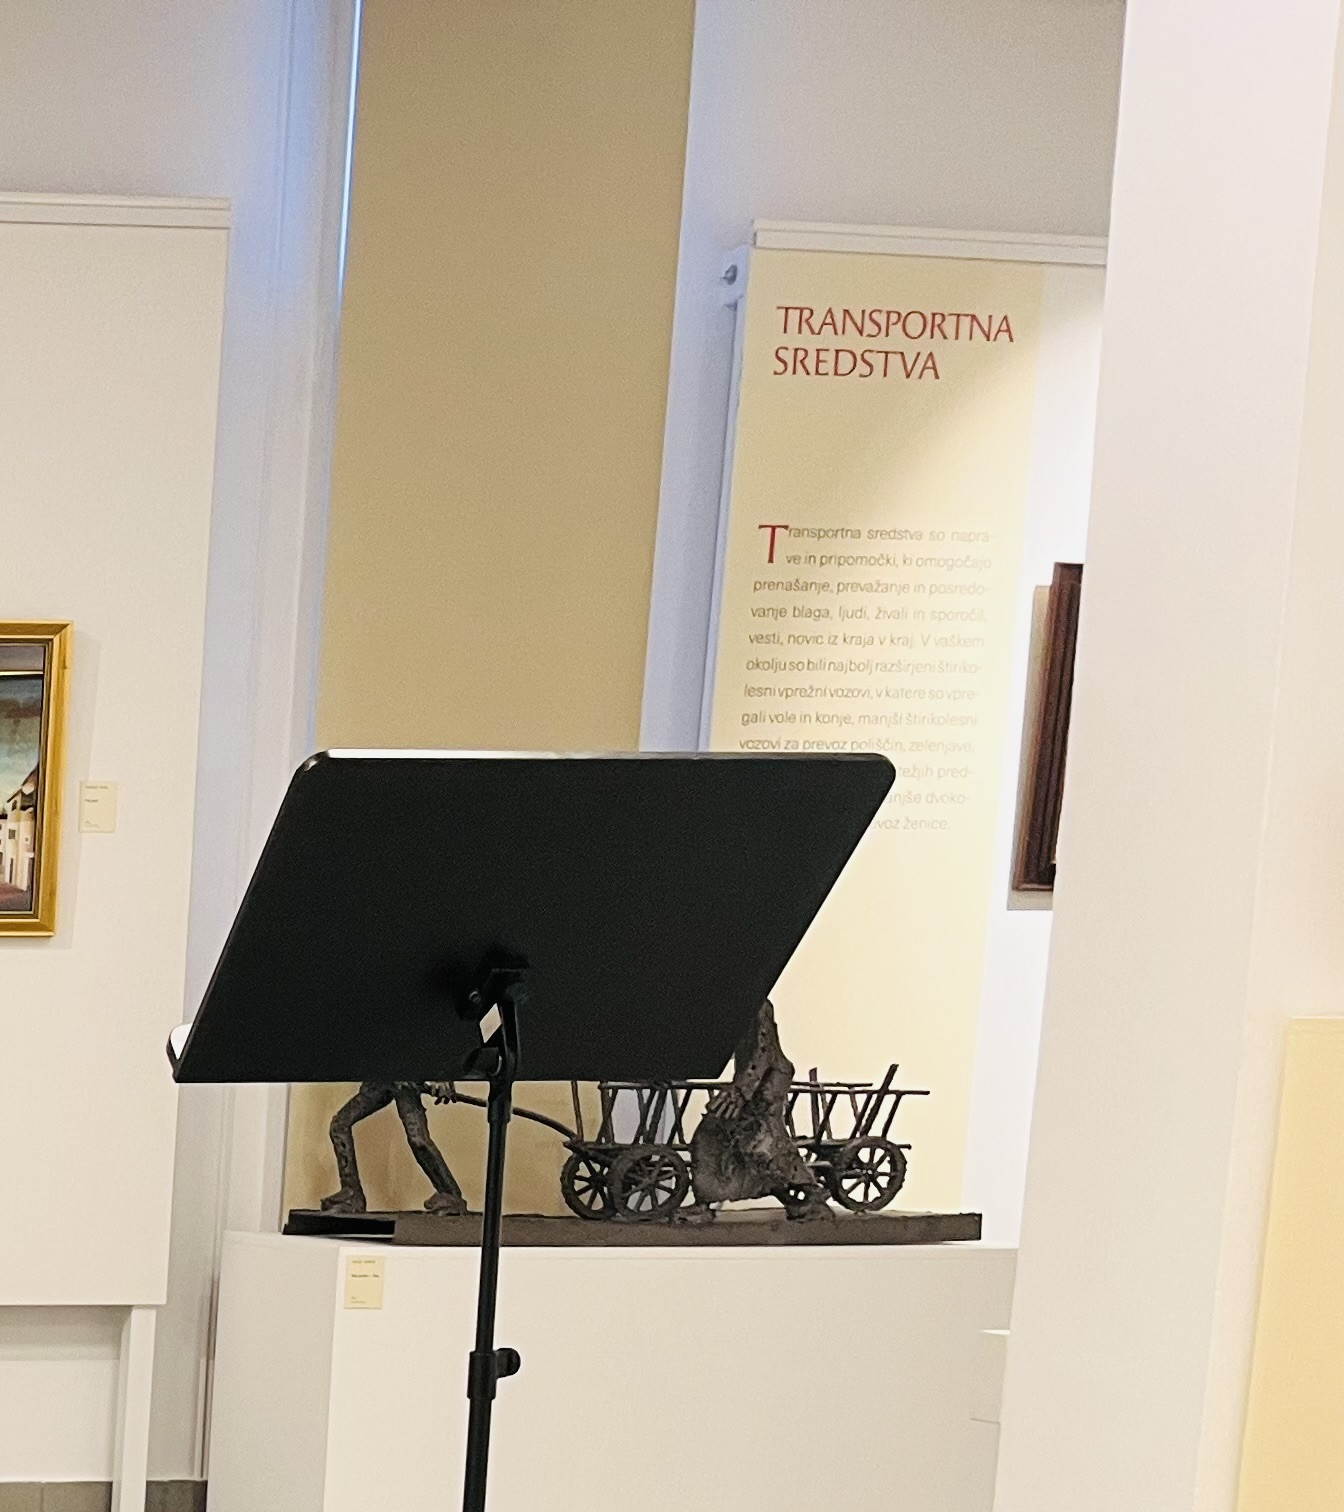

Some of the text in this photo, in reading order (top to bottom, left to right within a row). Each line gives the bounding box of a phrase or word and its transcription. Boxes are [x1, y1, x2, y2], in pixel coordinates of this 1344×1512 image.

[776, 306, 1014, 342] TRANSPORTNA
[773, 346, 940, 380] SREDSTVA
[867, 528, 922, 540] sredstva
[929, 530, 945, 542] so
[786, 555, 802, 566] ve
[804, 553, 816, 566] in
[902, 555, 912, 566] ki
[916, 556, 991, 572] omogočajo
[836, 580, 910, 594] prevažanje
[914, 582, 926, 594] in
[751, 606, 787, 621] vanje
[875, 606, 908, 620] živali
[914, 608, 924, 621] in
[788, 634, 823, 646] novic
[828, 634, 838, 646] iz
[842, 632, 874, 648] kraja
[879, 635, 886, 646] v
[920, 633, 931, 647] V
[934, 634, 984, 648] vaškem
[746, 658, 787, 672] okolju
[788, 660, 804, 672] so
[828, 658, 873, 674] najbolj
[744, 684, 776, 697] lesni
[778, 684, 826, 700] vprežni
[884, 686, 926, 700] katere
[928, 688, 944, 700] so
[742, 711, 766, 726] gali
[768, 712, 796, 724] vole
[800, 712, 812, 724] in
[858, 712, 903, 728] manjši
[738, 737, 781, 750] vozovi
[784, 740, 799, 751] za
